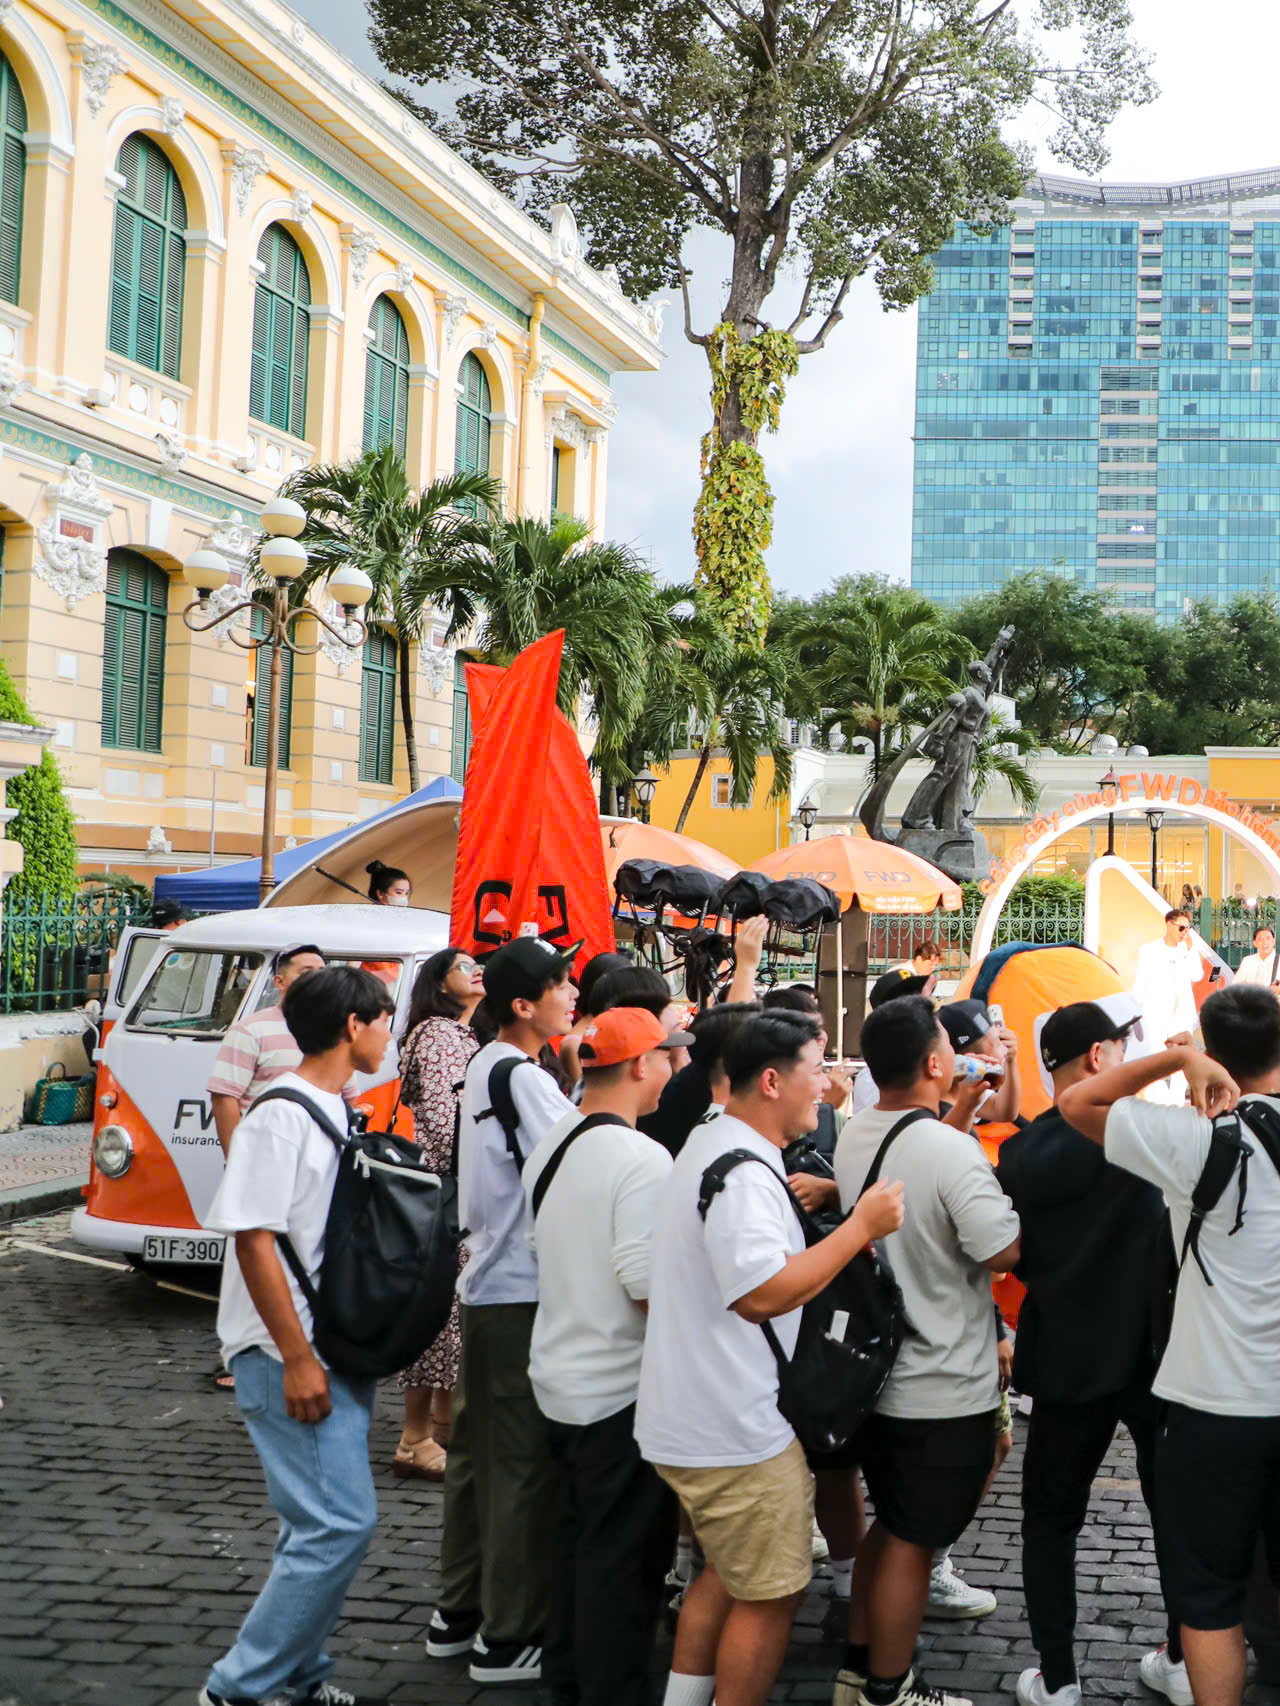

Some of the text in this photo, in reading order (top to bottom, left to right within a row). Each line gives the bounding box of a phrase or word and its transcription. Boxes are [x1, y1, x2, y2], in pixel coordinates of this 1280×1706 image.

[1120, 772, 1203, 806] FWD
[864, 871, 912, 883] FWD
[171, 1133, 222, 1146] insuranc
